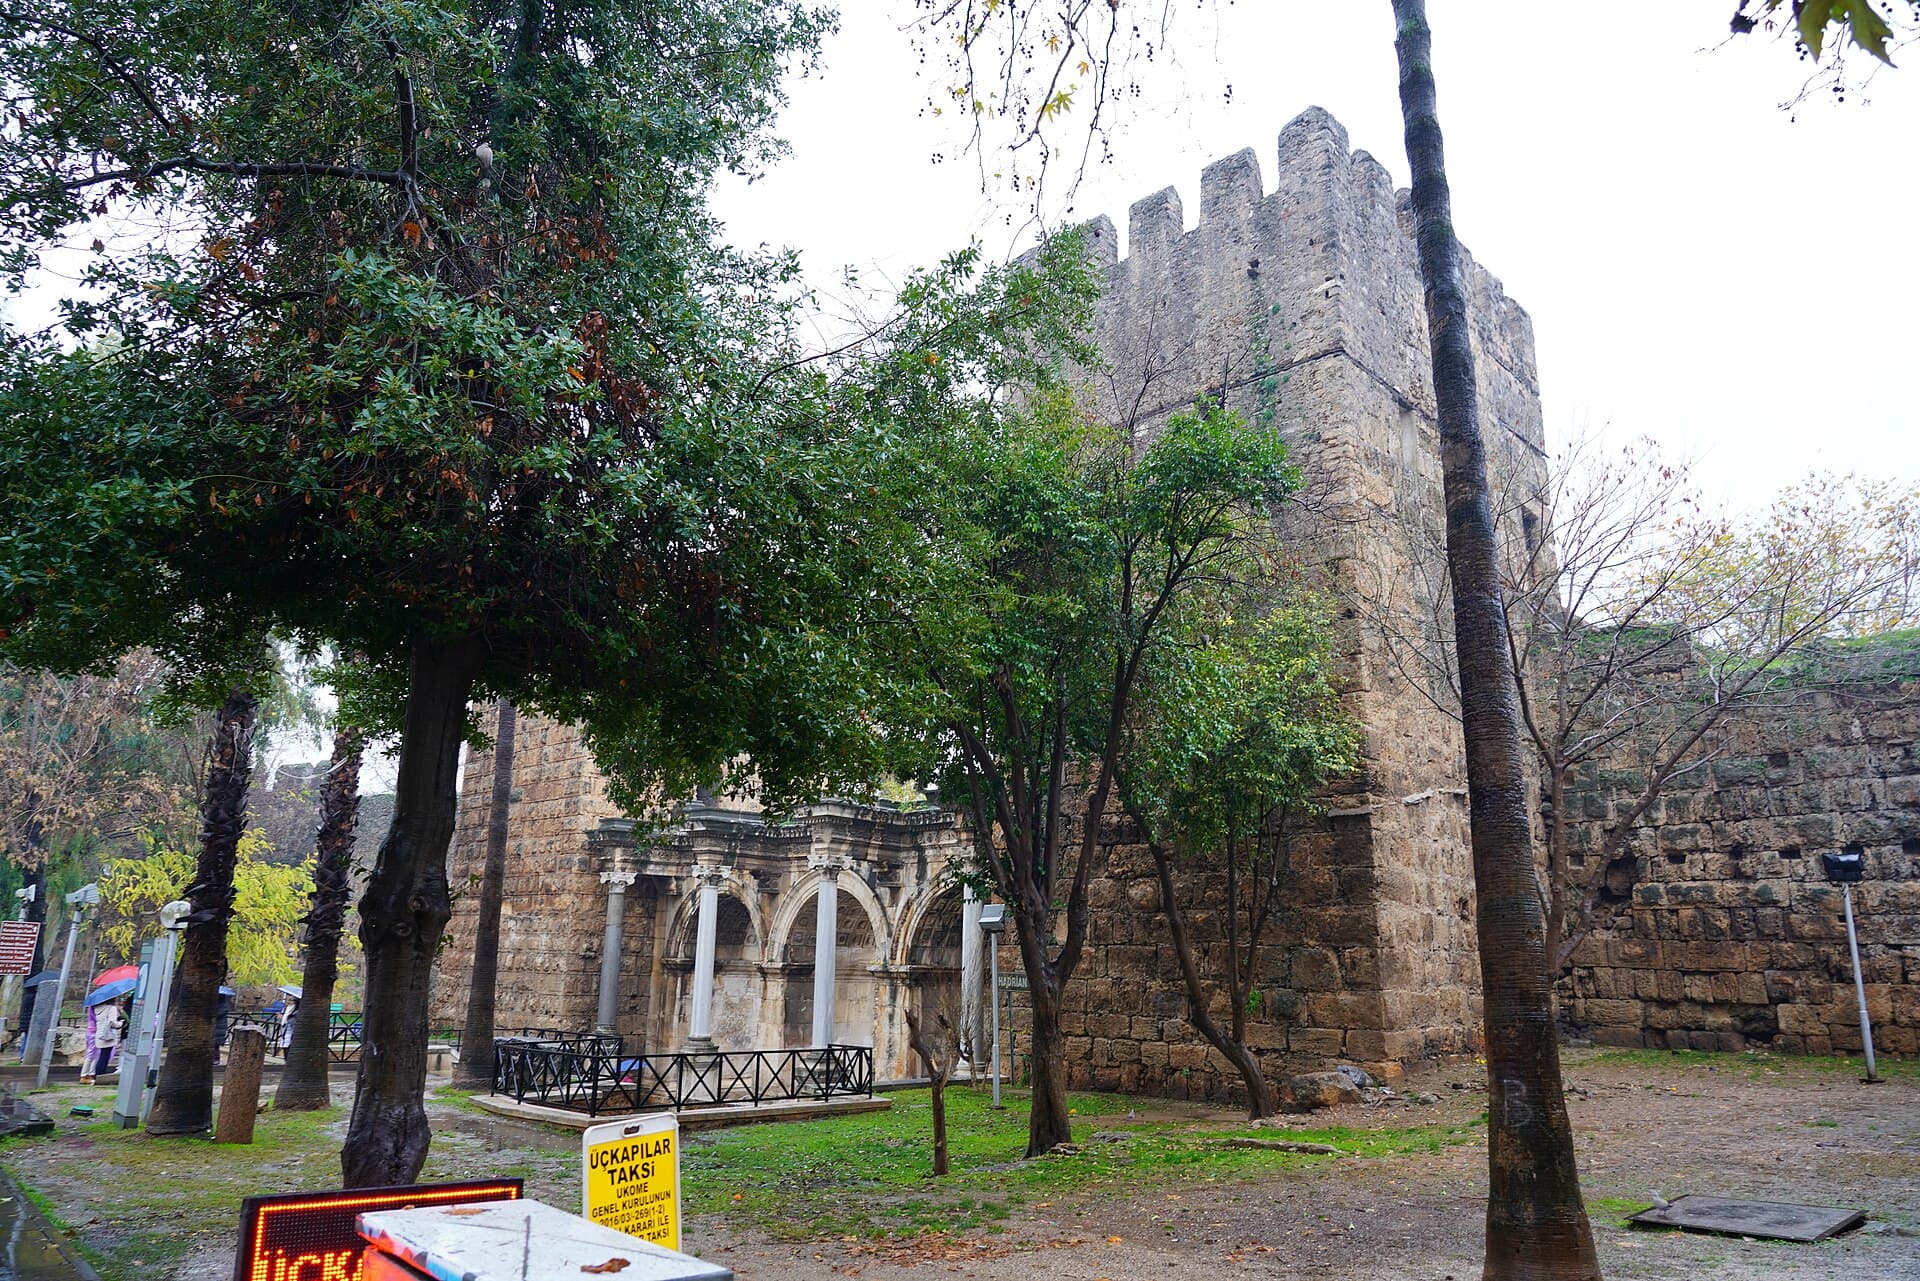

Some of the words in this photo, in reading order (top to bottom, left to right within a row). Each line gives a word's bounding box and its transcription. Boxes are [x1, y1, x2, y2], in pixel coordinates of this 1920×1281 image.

[590, 1138, 671, 1172] ÜÇKAPILAR
[592, 1203, 620, 1218] GENEL
[622, 1190, 671, 1211] KURULUNUN
[616, 1182, 648, 1199] UKOME
